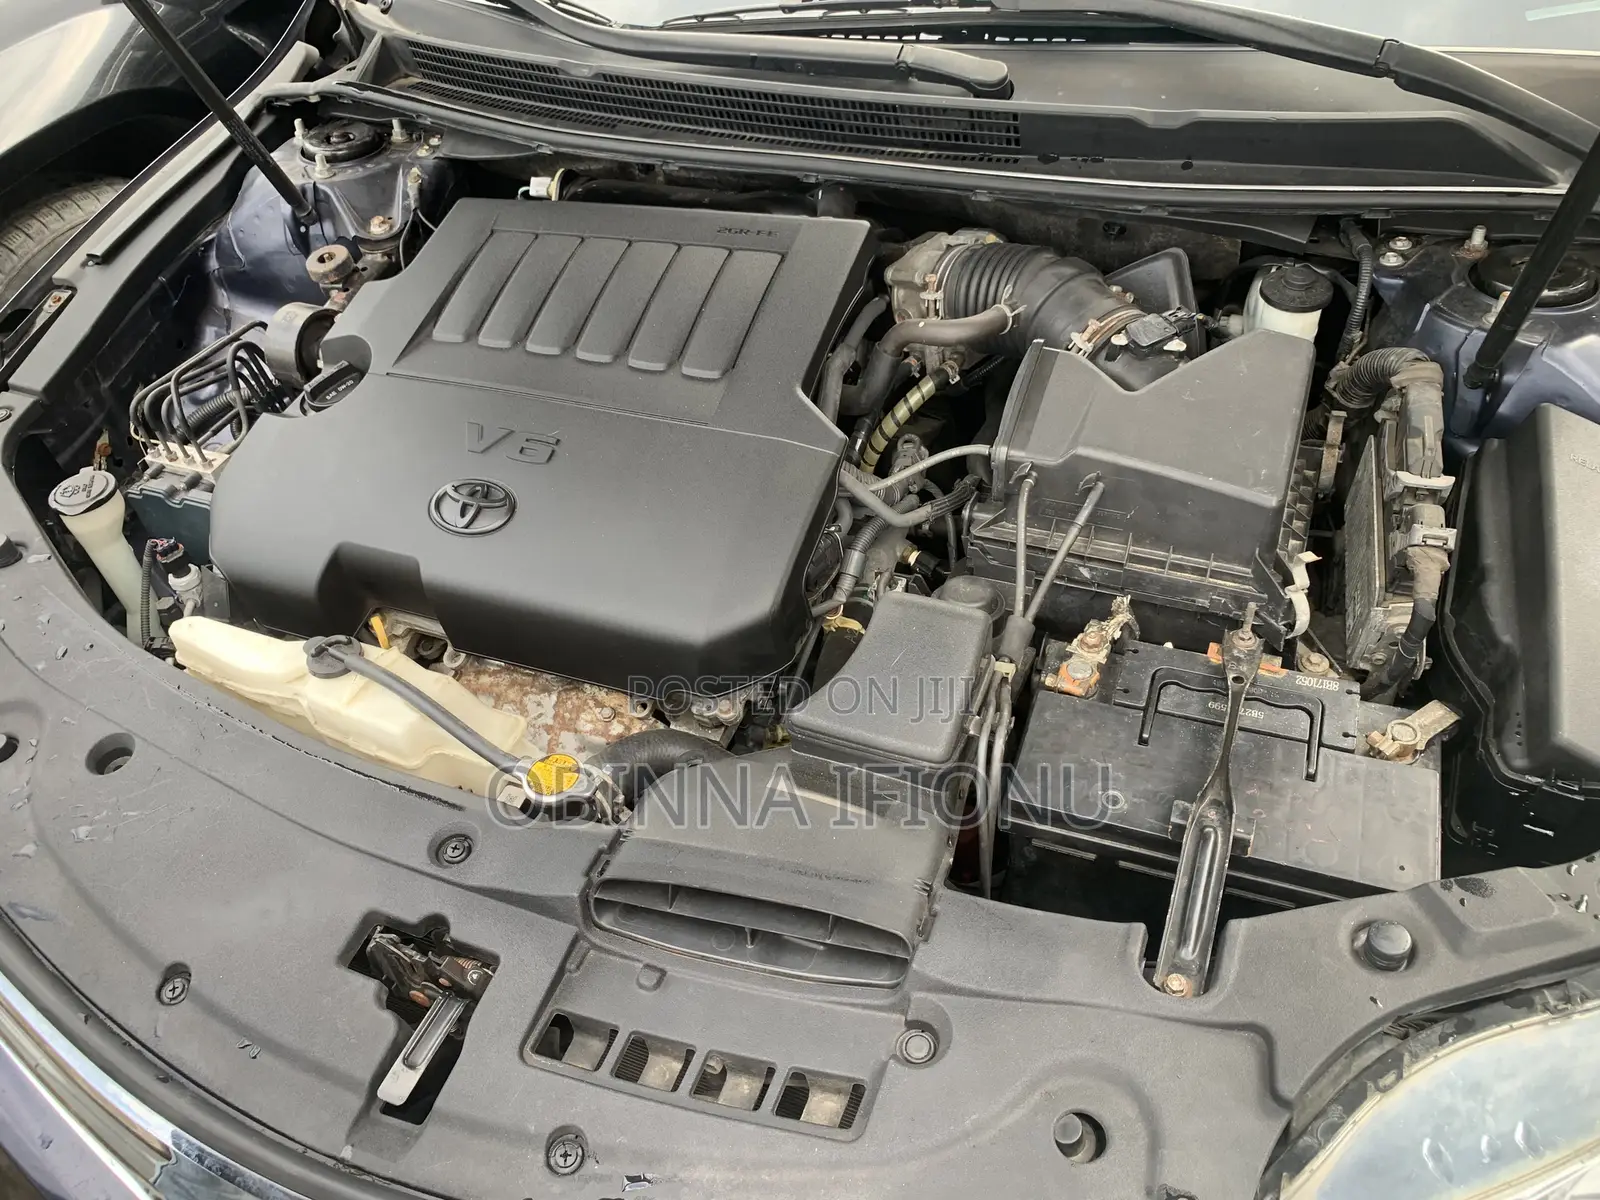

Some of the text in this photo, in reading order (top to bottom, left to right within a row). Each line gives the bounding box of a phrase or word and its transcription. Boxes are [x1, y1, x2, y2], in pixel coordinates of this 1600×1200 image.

[325, 390, 338, 400] SAE
[466, 421, 561, 465] V6
[1295, 675, 1340, 692] 8B171052
